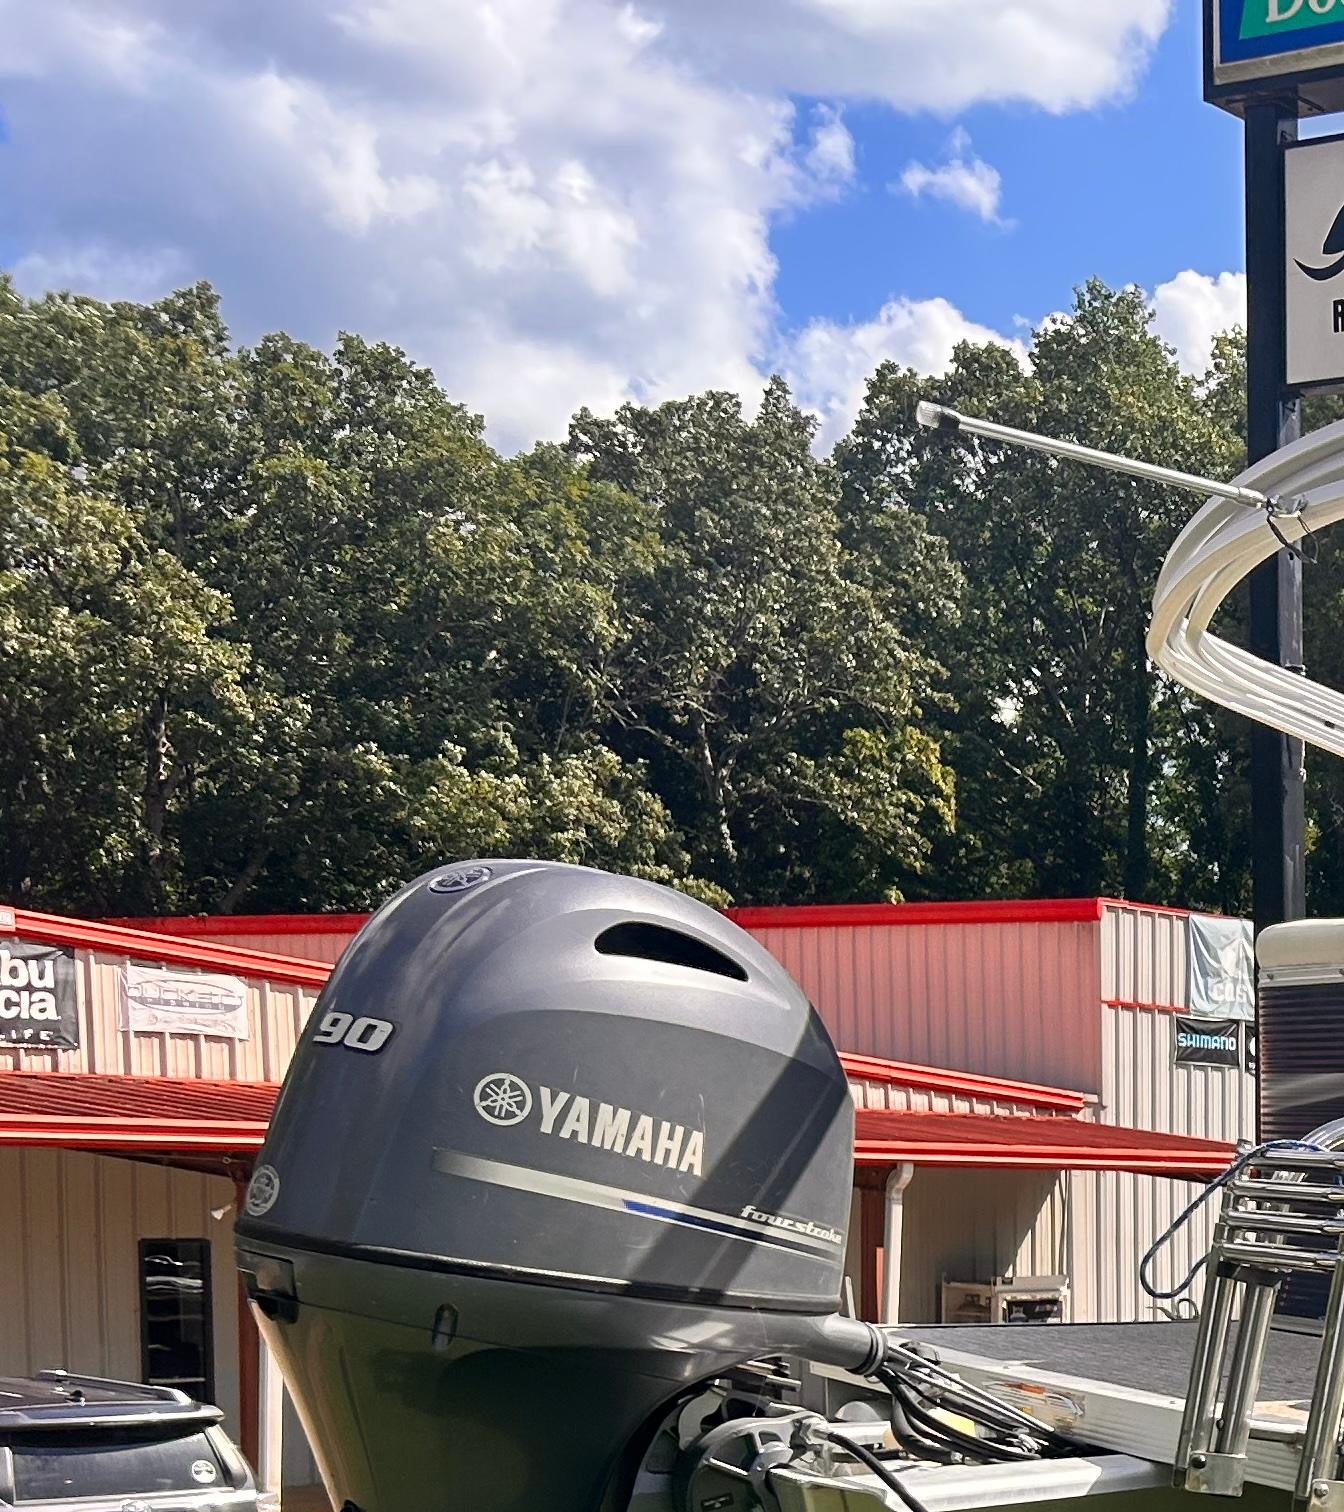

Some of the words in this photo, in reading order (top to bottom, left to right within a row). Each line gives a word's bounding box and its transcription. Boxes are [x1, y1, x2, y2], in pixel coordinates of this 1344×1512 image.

[312, 1012, 394, 1051] 90
[1177, 1032, 1237, 1051] SHIMANO
[539, 1086, 704, 1177] YAMAHA
